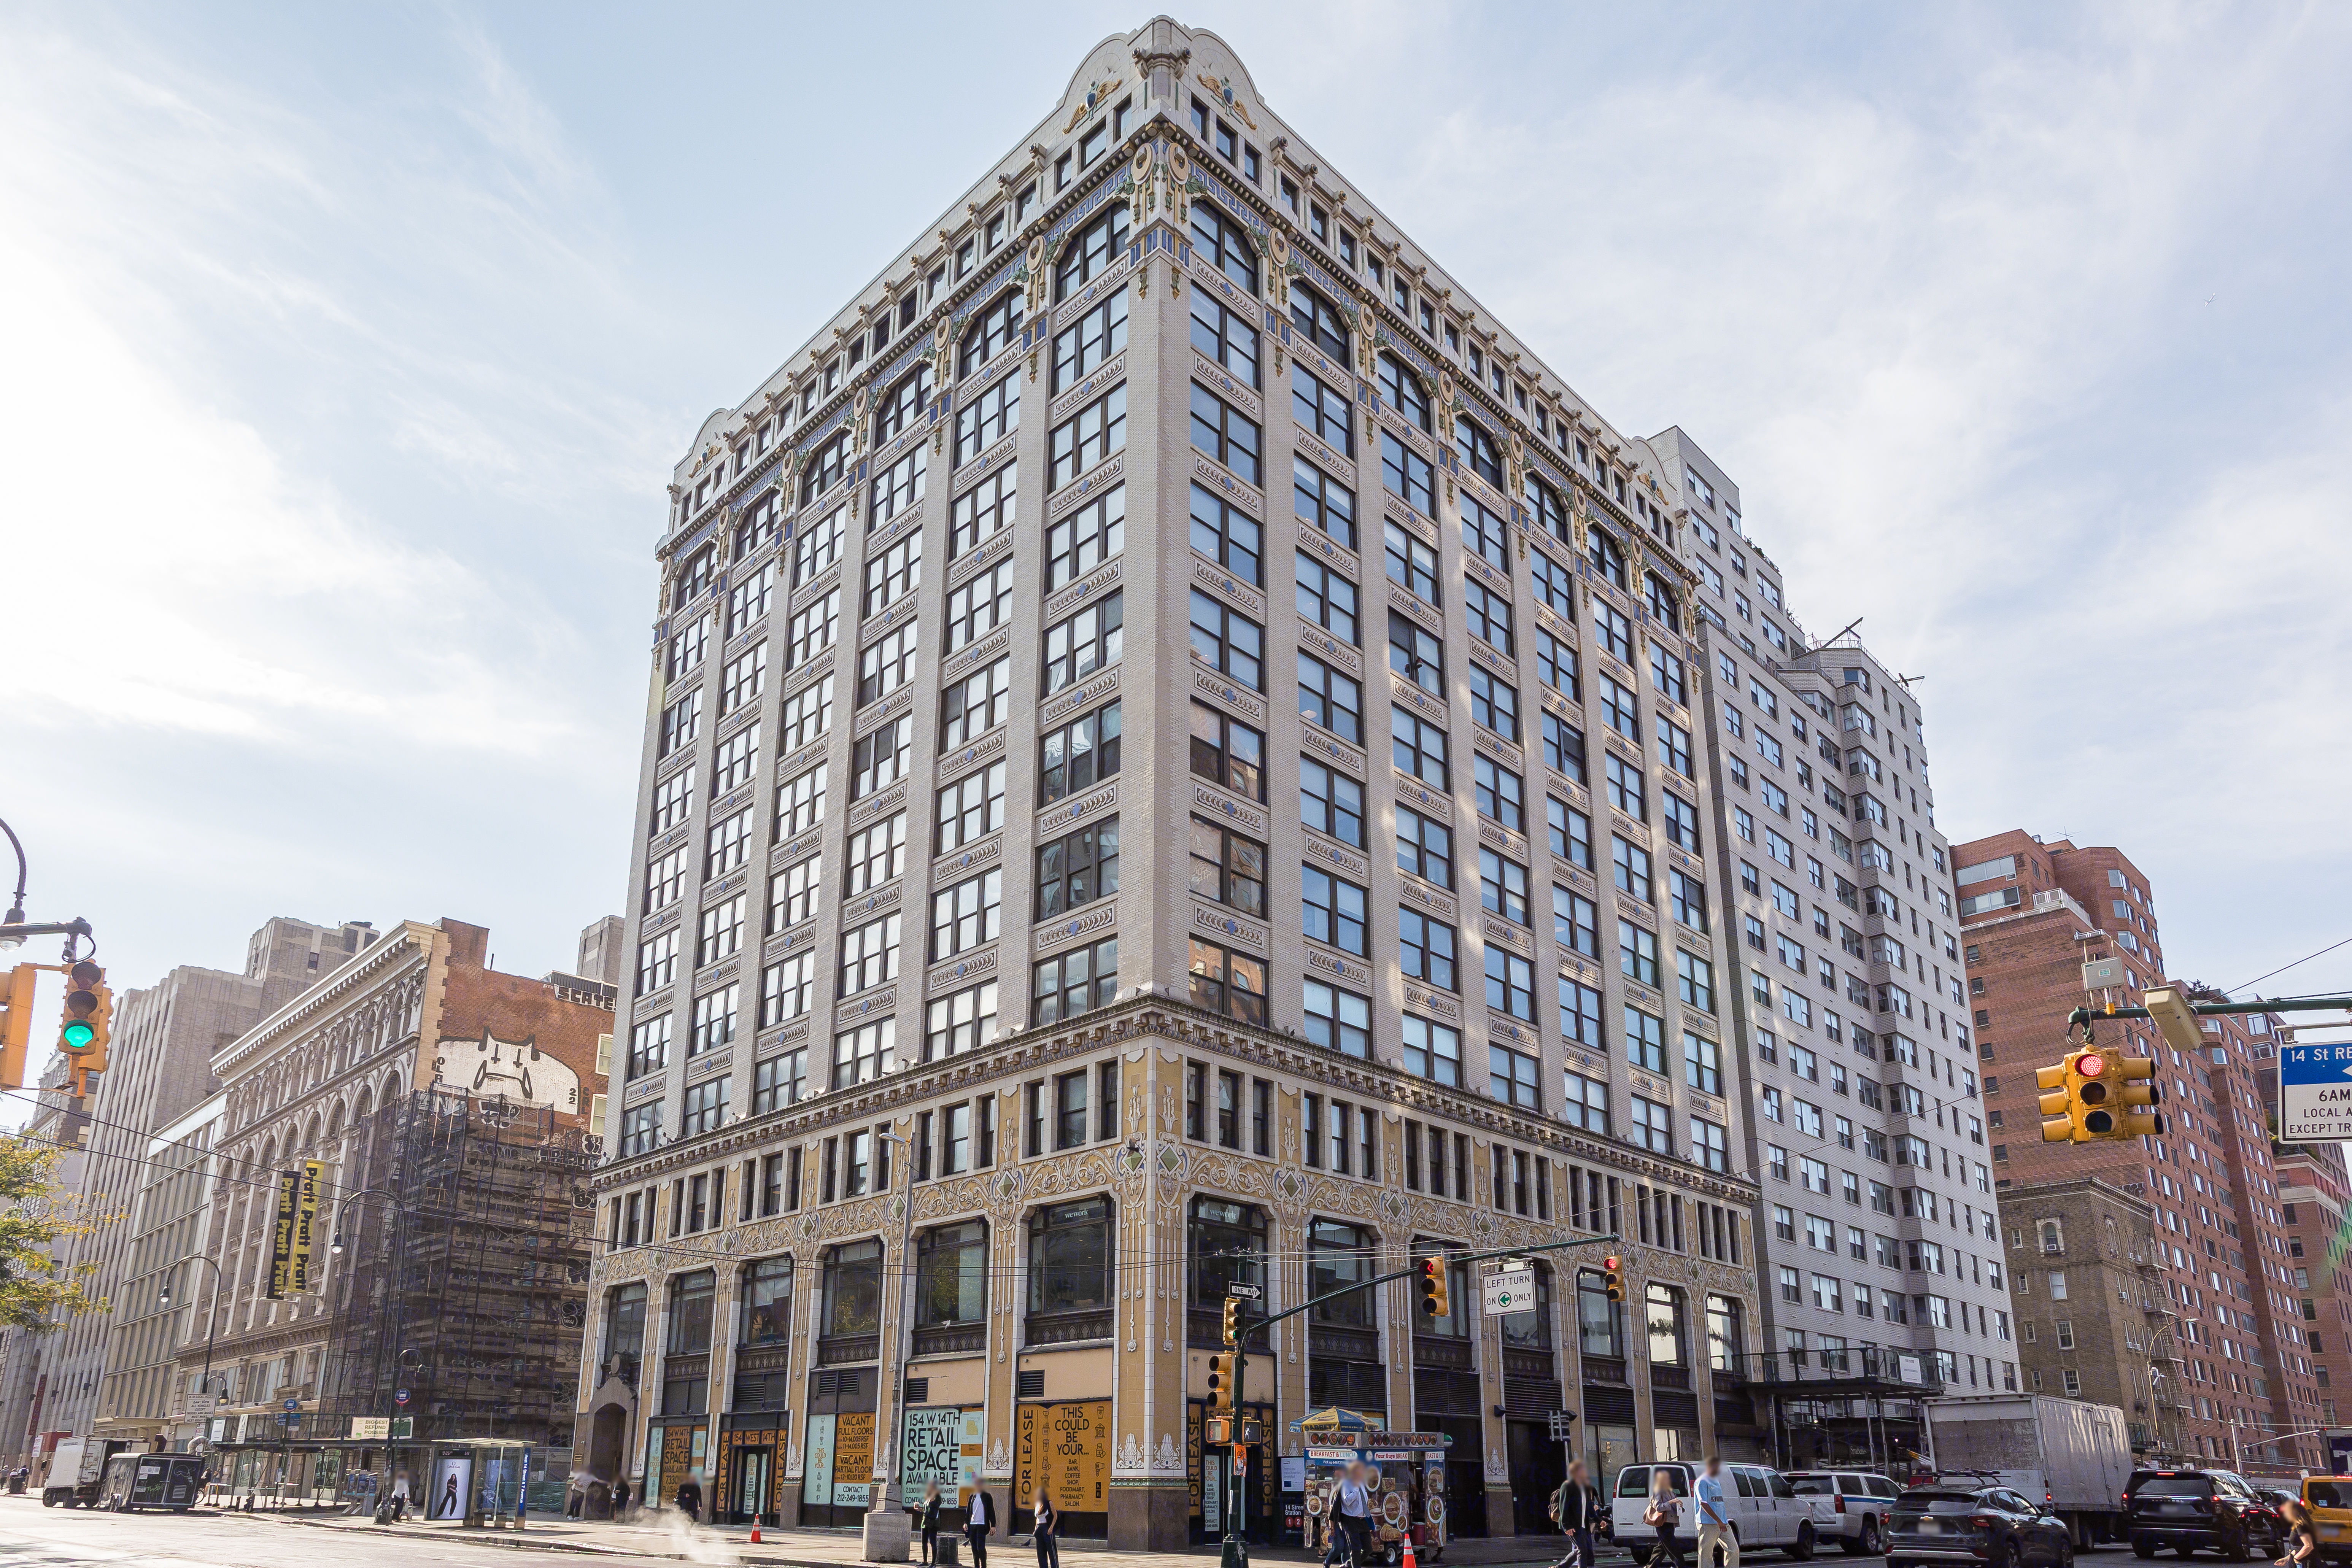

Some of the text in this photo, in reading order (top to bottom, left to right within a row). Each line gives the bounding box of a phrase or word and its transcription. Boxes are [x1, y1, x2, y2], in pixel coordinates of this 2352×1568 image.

[558, 987, 617, 1010] SCATE
[2291, 1050, 2305, 1062] 14
[2314, 1049, 2328, 1061] St
[2304, 1108, 2341, 1118] LOCAL
[2290, 1123, 2351, 1133] EXCEPT TR
[1065, 1208, 1089, 1218] wework
[1209, 1209, 1236, 1220] wework
[296, 1168, 317, 1290] Pratt Pratt Pratt
[274, 1178, 294, 1297] Pratt Pratt Pratt
[1487, 1275, 1530, 1288] LEFT TURN
[1487, 1293, 1531, 1305] ON ONLY
[909, 1412, 960, 1426] 154 W 14TH
[1061, 1406, 1083, 1419] THIS
[842, 1416, 871, 1426] VACANT
[1055, 1419, 1089, 1431] COULD
[746, 1433, 760, 1441] WEST
[763, 1433, 776, 1441] 14TH
[908, 1427, 959, 1447] RETAIL
[1066, 1431, 1078, 1442] BE
[666, 1438, 689, 1450] RETAIL
[1057, 1444, 1089, 1455] YOUR...
[665, 1451, 689, 1464] SPACE
[840, 1455, 869, 1465] VACANT
[906, 1449, 959, 1471] SPACE
[1021, 1409, 1033, 1504] FOR LEASE
[1189, 1415, 1199, 1507] FOR LEASE
[1262, 1420, 1272, 1506] FOR LEASE
[906, 1472, 958, 1485] AVAILABLE
[837, 1494, 869, 1502] 212-249-1855
